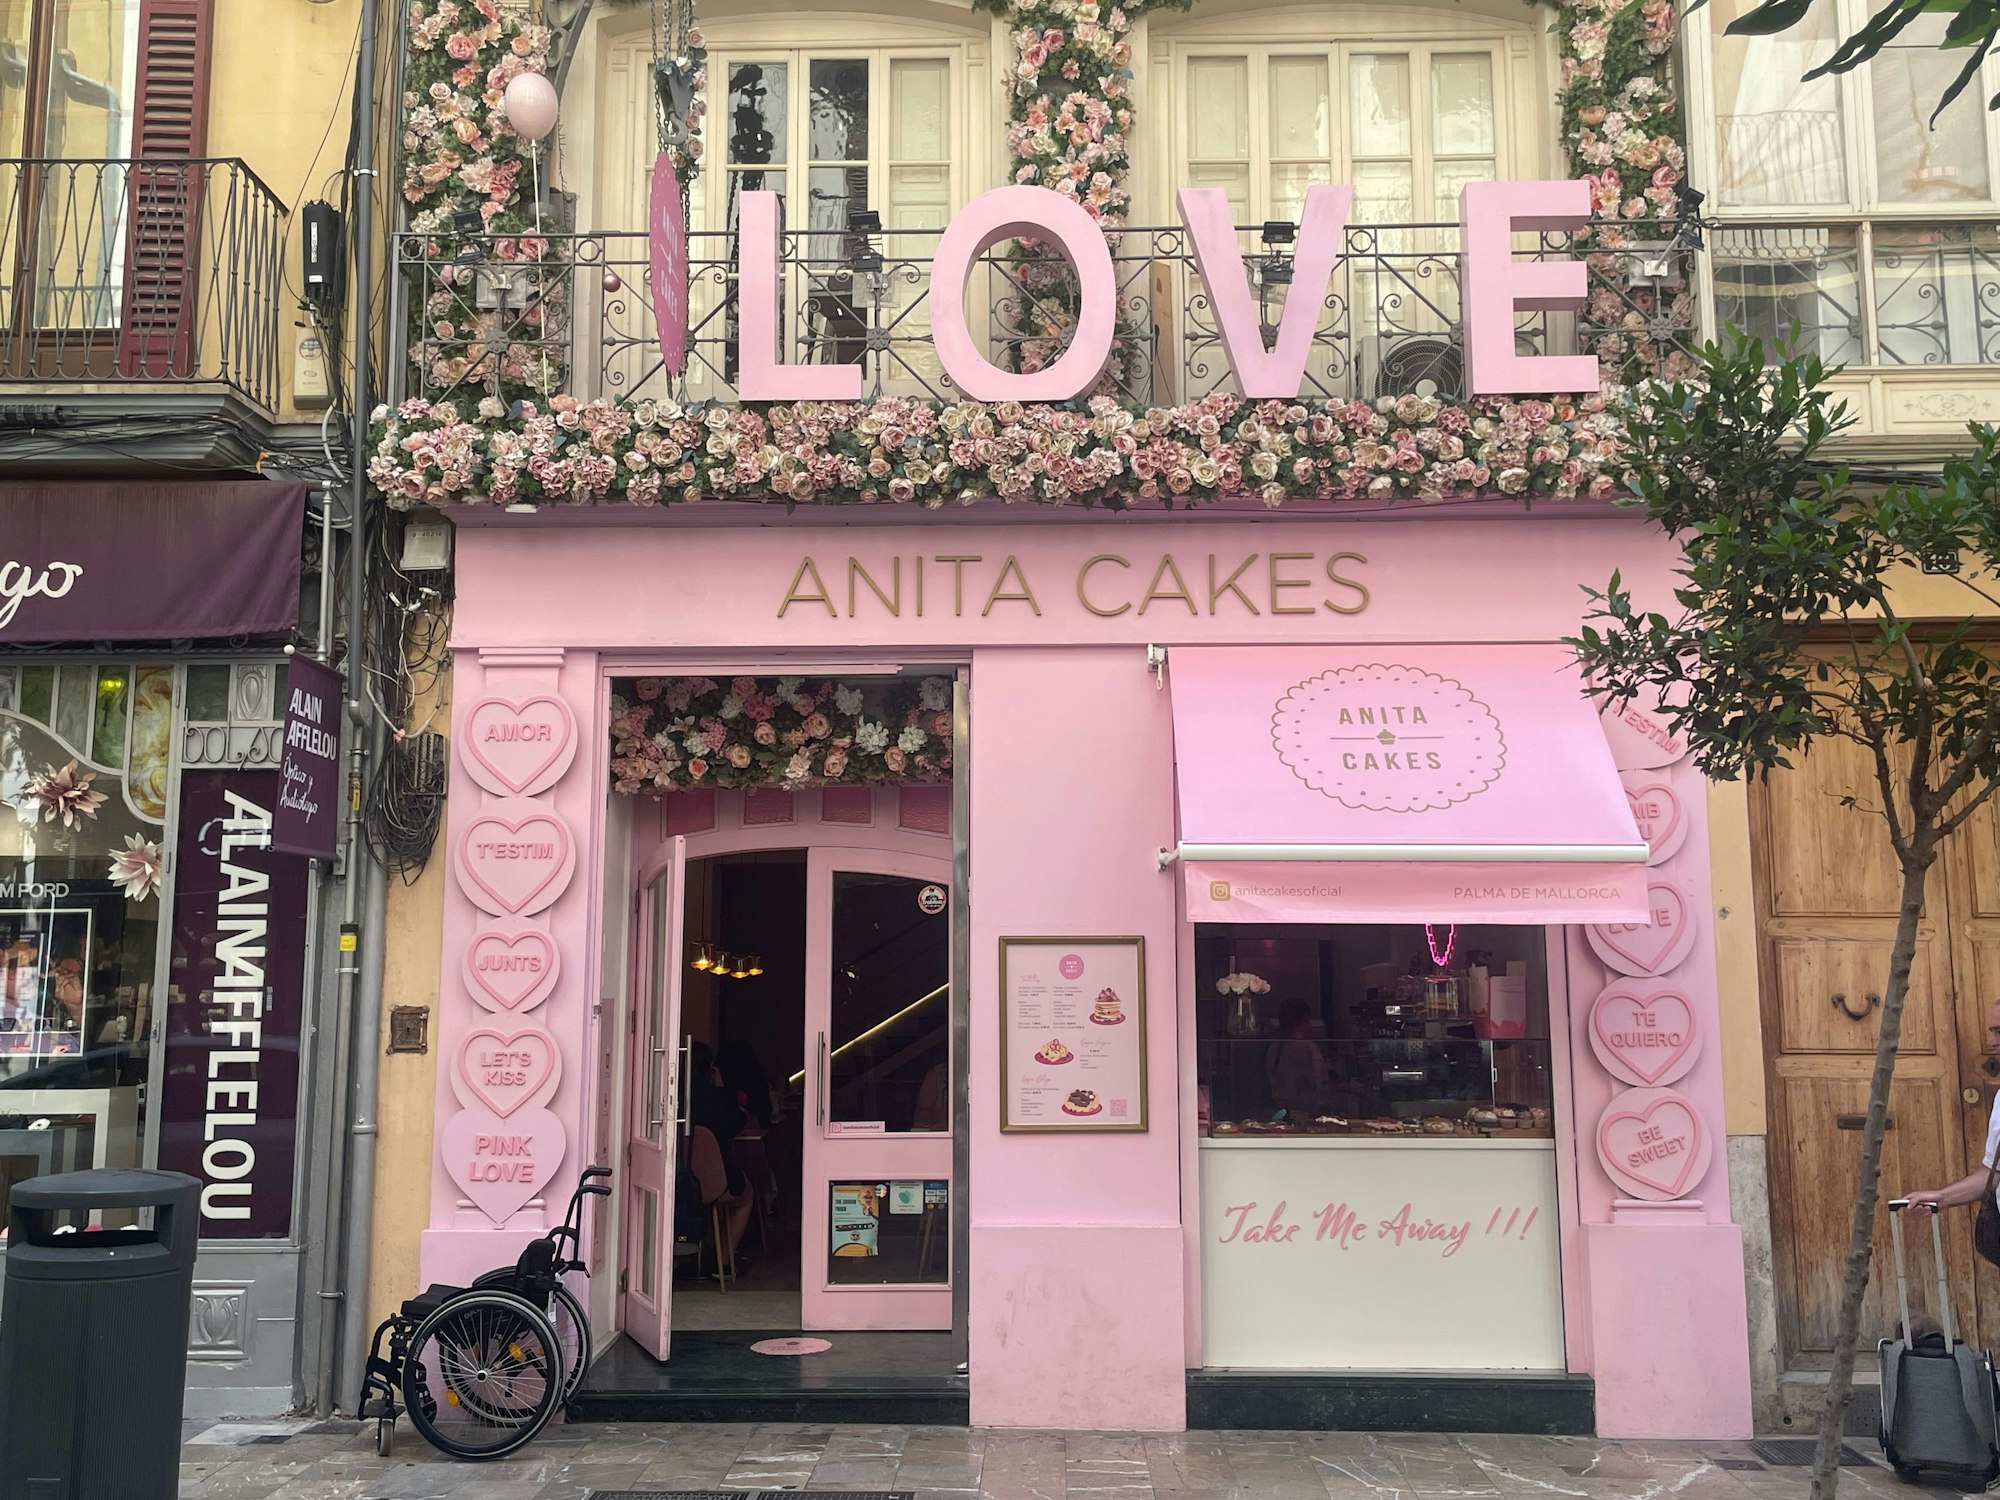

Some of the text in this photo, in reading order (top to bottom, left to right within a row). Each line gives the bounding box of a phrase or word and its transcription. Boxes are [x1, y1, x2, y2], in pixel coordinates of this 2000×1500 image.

[738, 181, 1600, 402] LOVE
[777, 551, 1370, 618] ANITA CAKES
[289, 687, 323, 724] ALAIN
[1339, 706, 1428, 725] ANITA
[286, 720, 337, 760] AFFLELOU
[484, 723, 552, 742] AMOR
[1342, 752, 1442, 770] CAKES
[307, 775, 314, 794] y
[1630, 802, 1660, 820] MB
[1638, 823, 1653, 841] U
[476, 842, 553, 860] T'ESTIM
[18, 882, 70, 899] FORD
[1234, 884, 1343, 898] anitacakesoficial
[1453, 887, 1621, 899] PALMA DE MALLORCA
[479, 954, 542, 972] JUNTS
[1632, 1011, 1657, 1028] TE
[1610, 1031, 1682, 1048] QUIERO
[481, 1051, 532, 1068] LET'S
[484, 1069, 527, 1086] KISS
[1637, 1126, 1665, 1146] BE
[475, 1134, 533, 1157] PINK
[1627, 1135, 1686, 1169] SWEET
[469, 1161, 535, 1184] LOVE
[1218, 1200, 1301, 1244] Take
[1312, 1202, 1368, 1251] Me
[1377, 1202, 1471, 1258] Away
